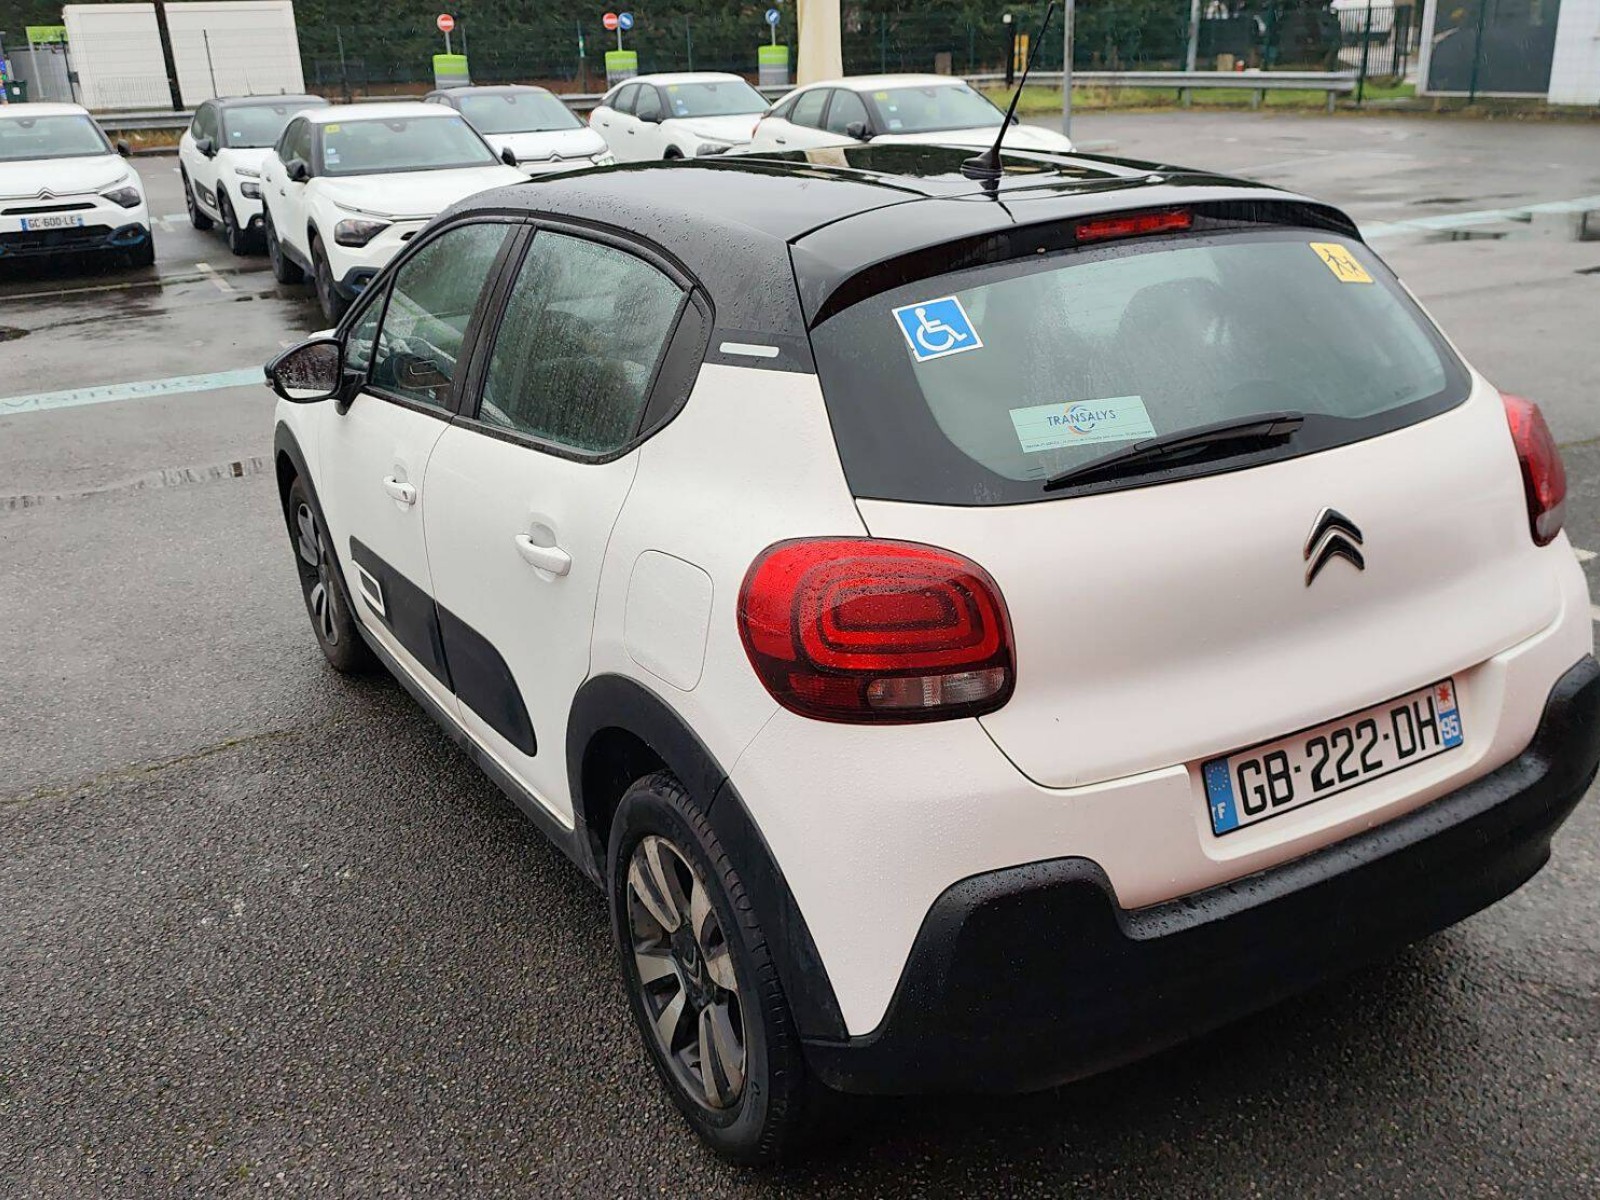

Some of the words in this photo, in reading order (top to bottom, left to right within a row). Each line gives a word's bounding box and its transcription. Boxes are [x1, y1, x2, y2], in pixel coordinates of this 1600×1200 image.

[1047, 409, 1116, 427] TRANSALYS
[1441, 715, 1460, 739] 95
[1237, 696, 1440, 816] GB-222-DH
[1217, 801, 1226, 819] F
